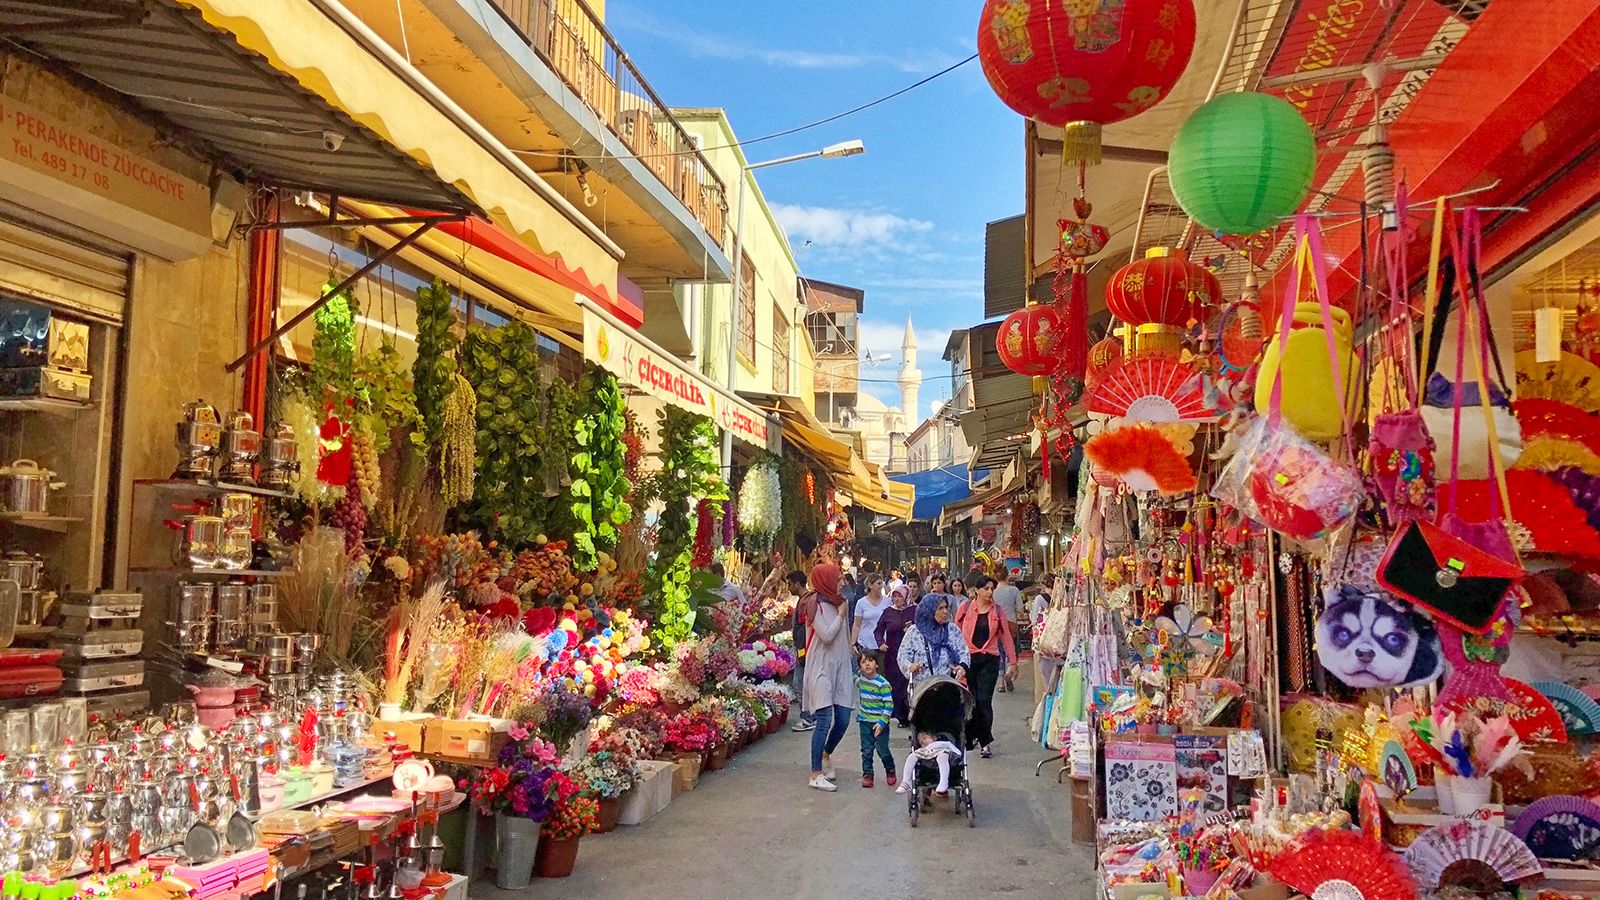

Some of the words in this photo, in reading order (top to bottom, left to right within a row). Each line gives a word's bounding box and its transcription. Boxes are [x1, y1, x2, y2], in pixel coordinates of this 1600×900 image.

[12, 138, 37, 161] Tel.
[42, 151, 67, 172] 489
[71, 163, 87, 180] 17
[93, 172, 110, 190] 08
[16, 111, 109, 168] PERAKENDE
[113, 154, 184, 201] ZÜCCACİYE
